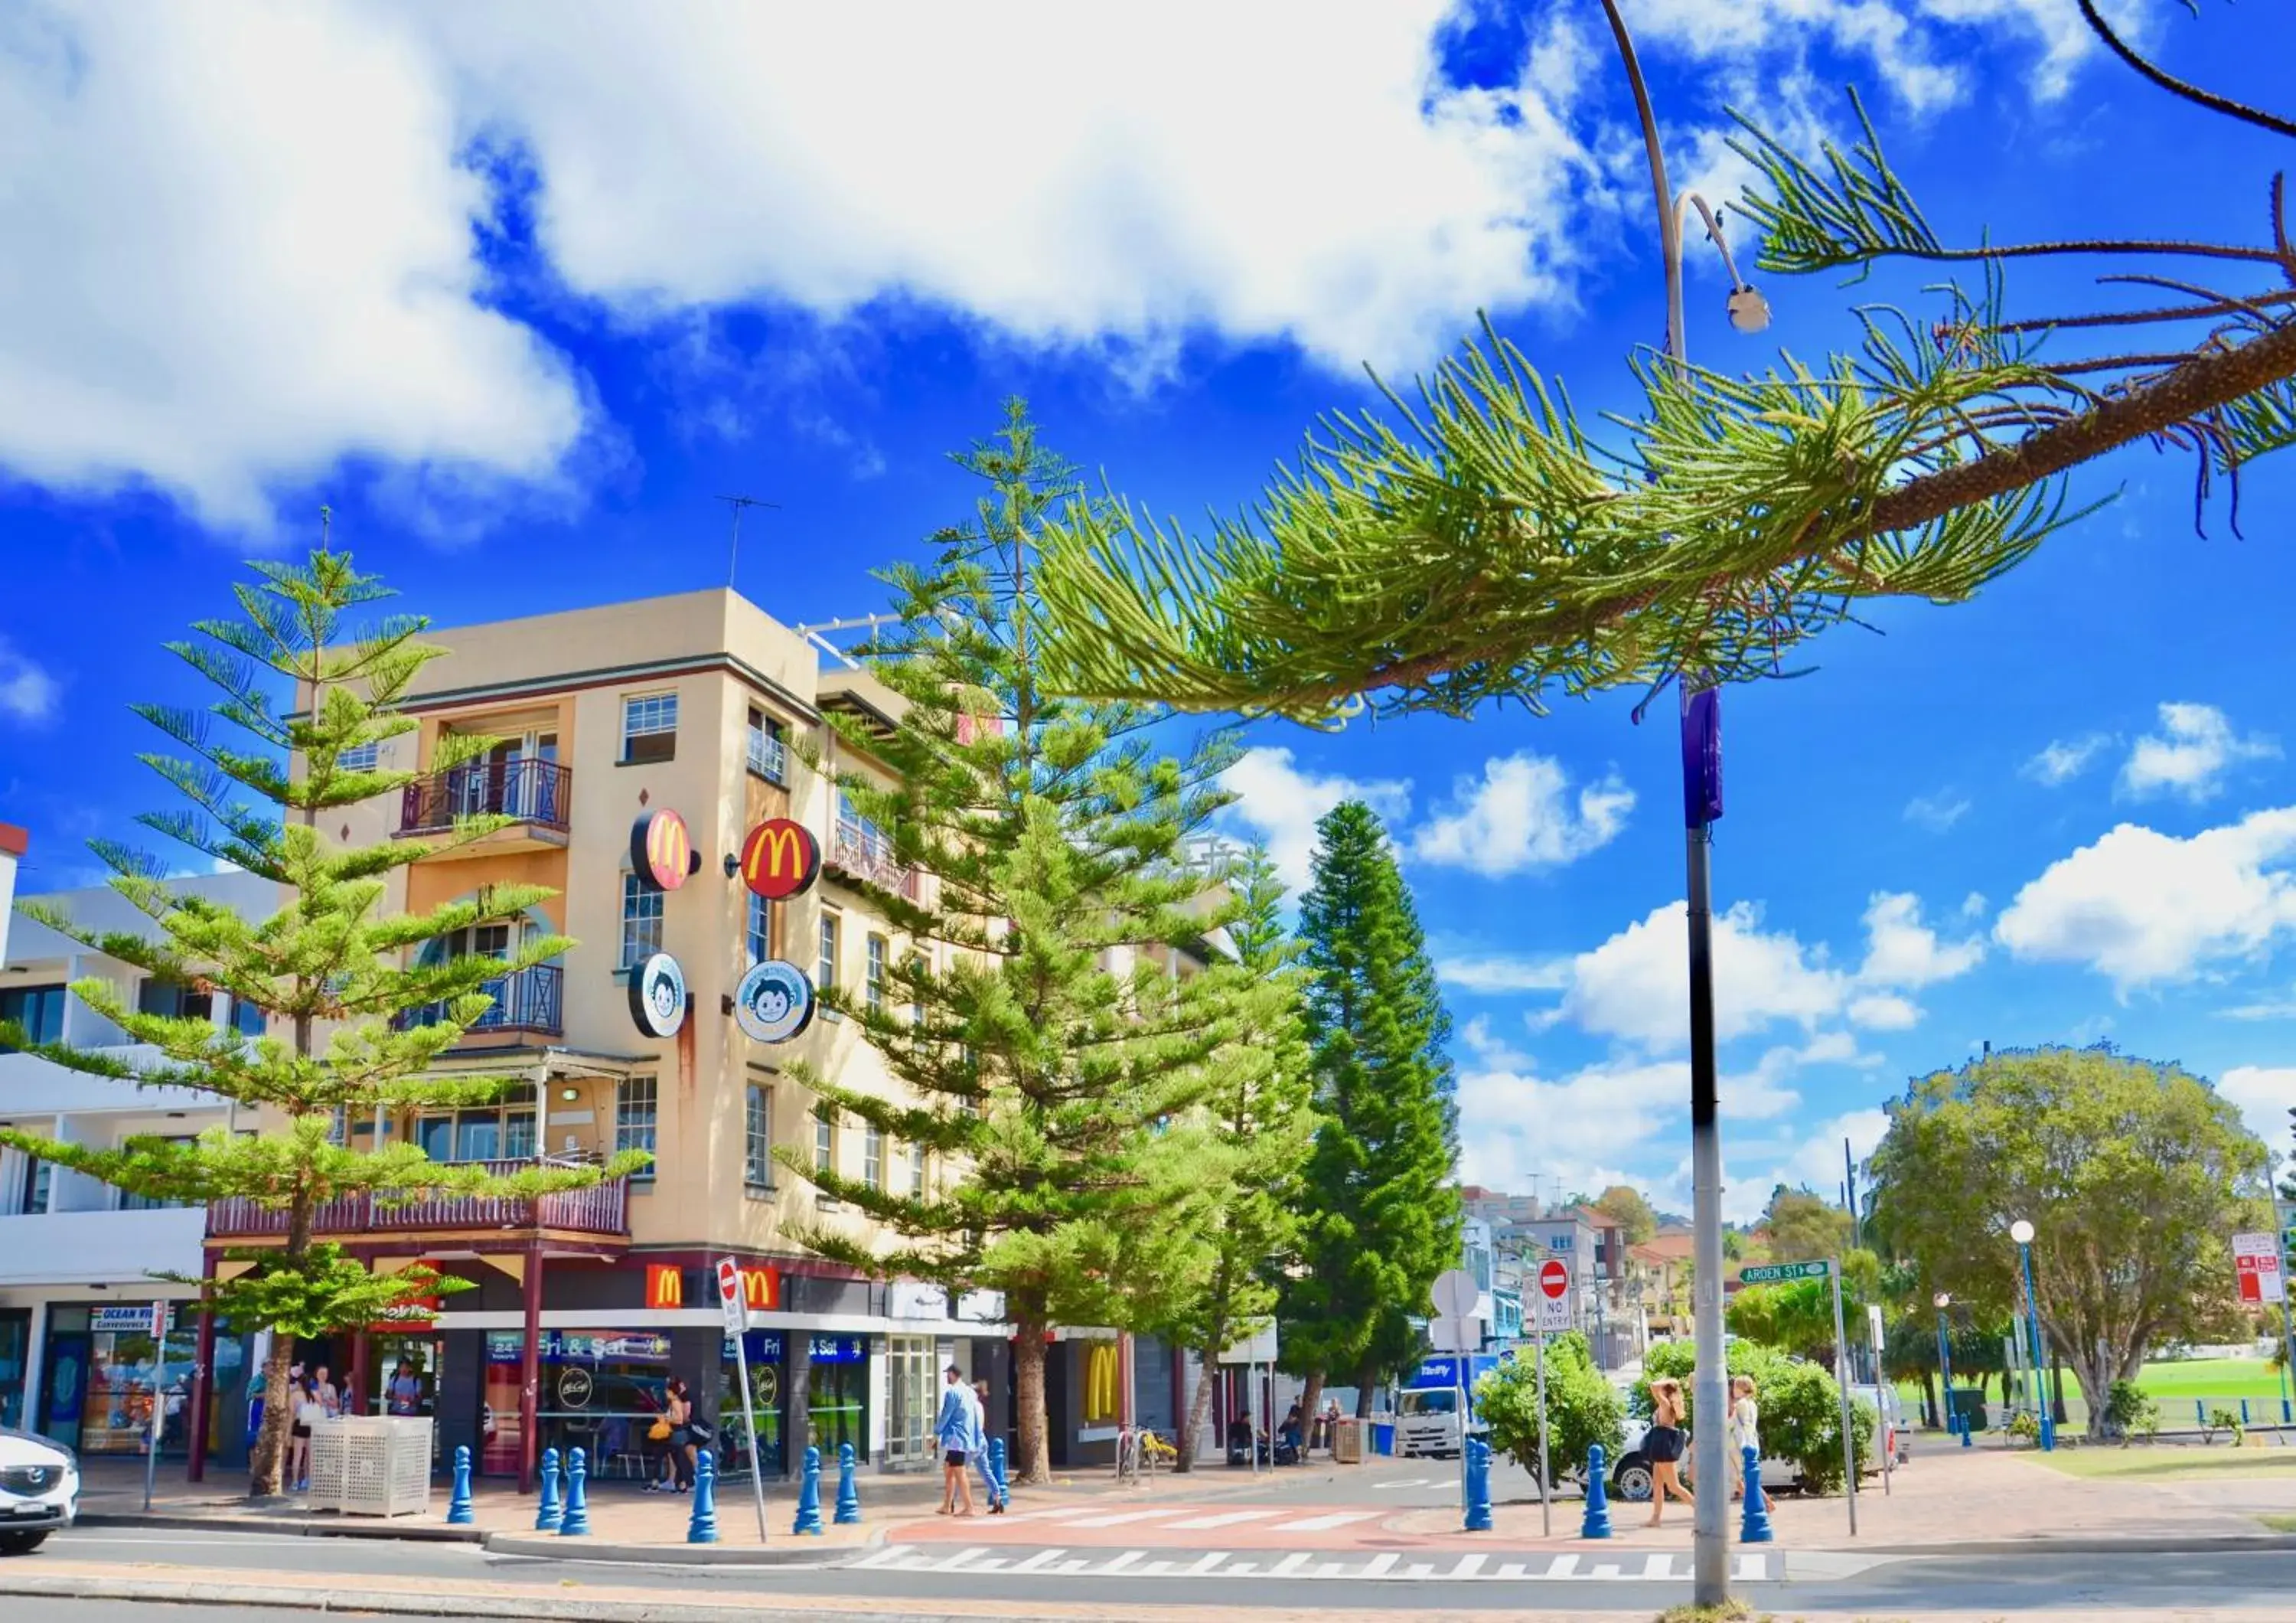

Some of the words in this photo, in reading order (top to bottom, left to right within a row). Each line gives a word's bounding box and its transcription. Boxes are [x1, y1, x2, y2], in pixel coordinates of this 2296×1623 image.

[1746, 1267, 1781, 1281] ARDEN
[1786, 1265, 1796, 1278] ST
[1548, 1301, 1562, 1313] NO
[103, 1308, 137, 1318] OCEAN
[1542, 1316, 1567, 1326] ENTRY
[495, 1343, 514, 1353] 24
[765, 1339, 781, 1355] Fri
[820, 1340, 838, 1356] Sat
